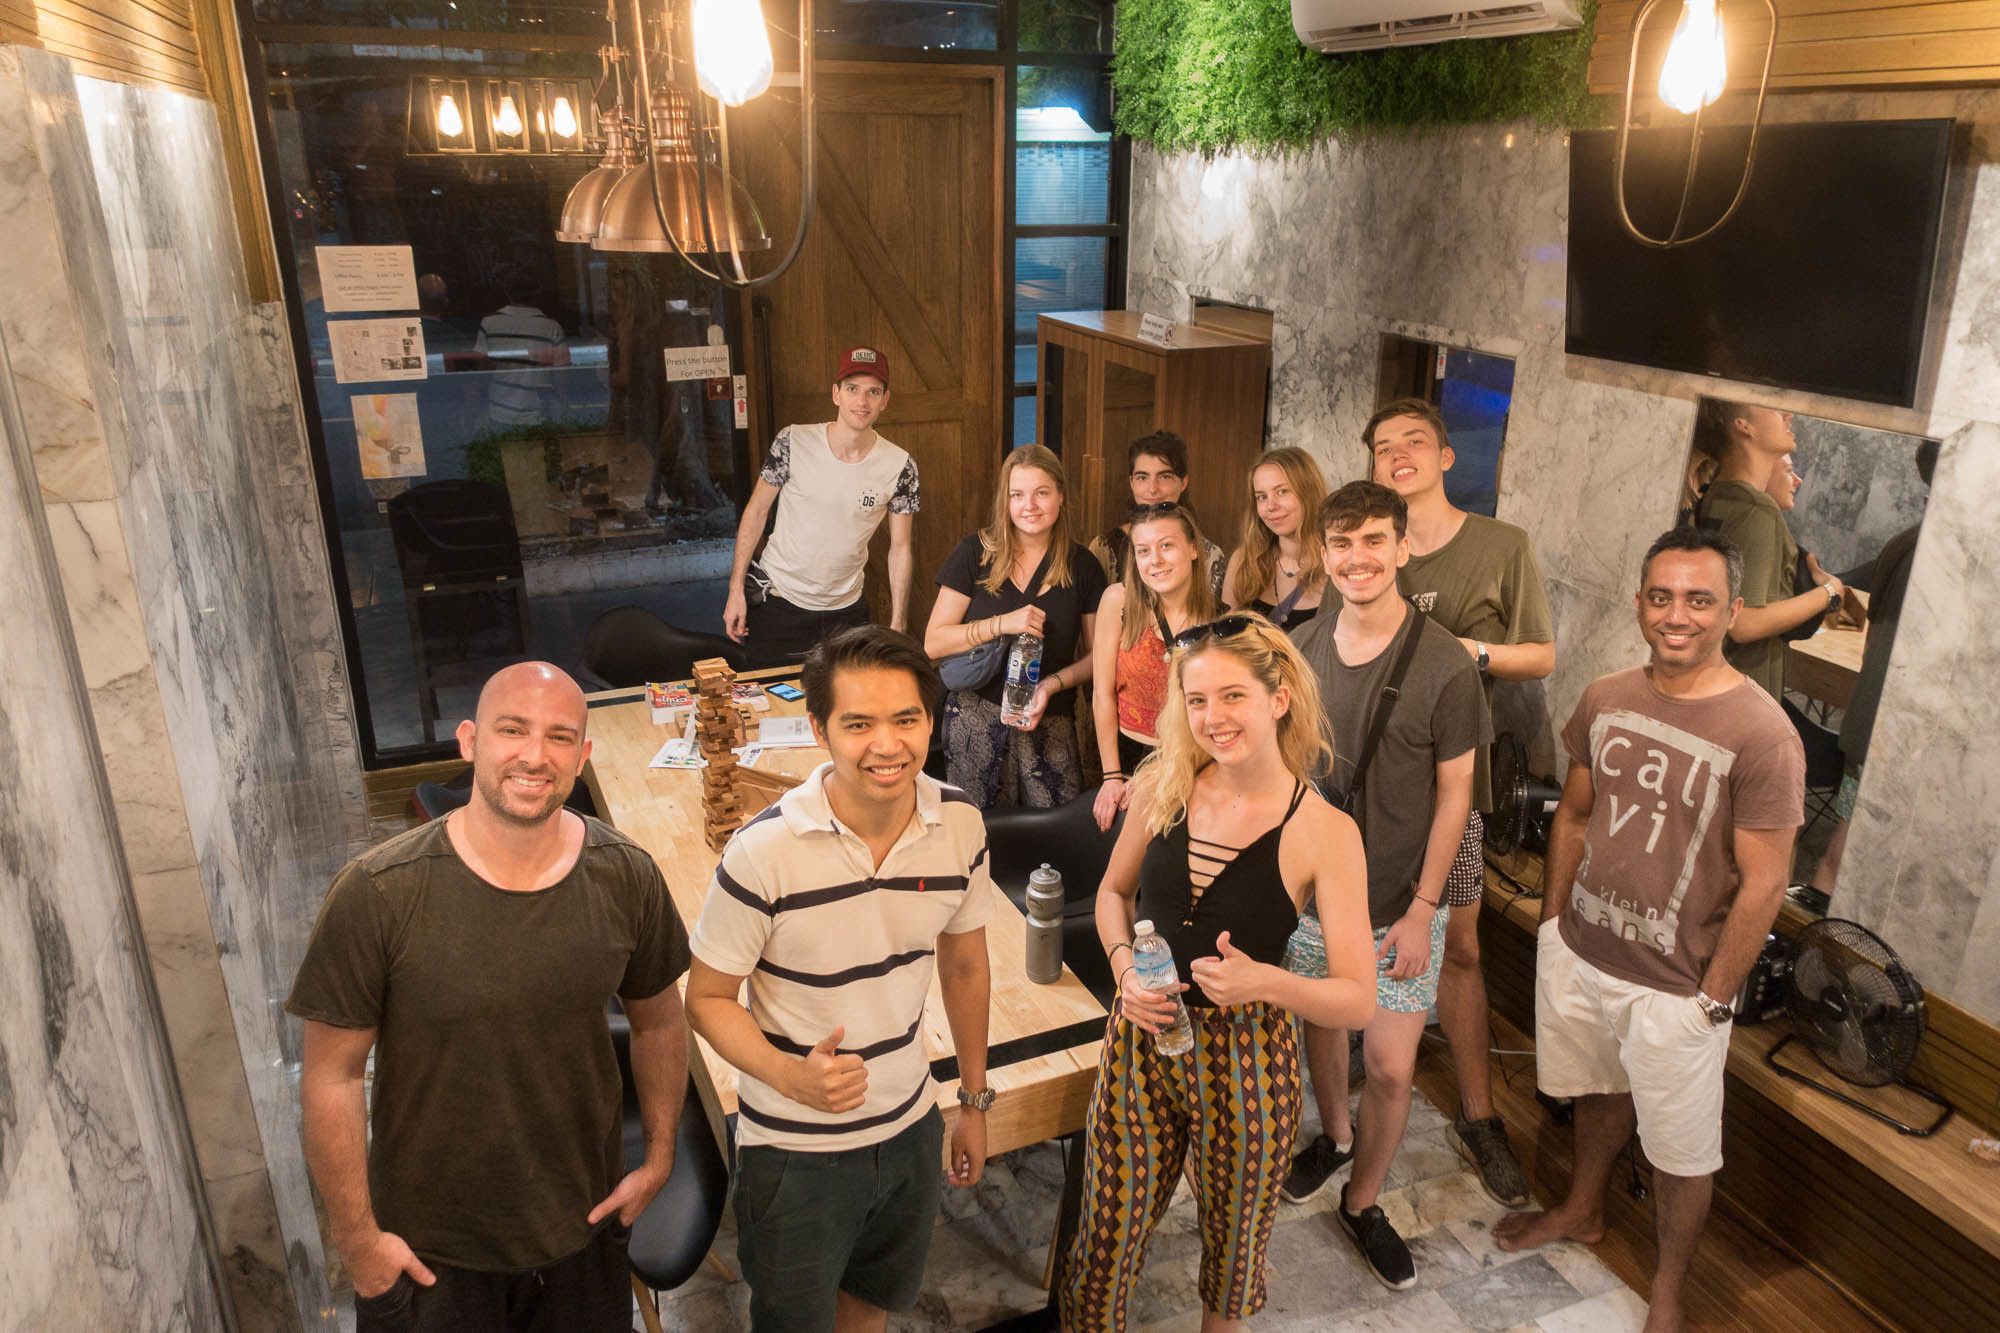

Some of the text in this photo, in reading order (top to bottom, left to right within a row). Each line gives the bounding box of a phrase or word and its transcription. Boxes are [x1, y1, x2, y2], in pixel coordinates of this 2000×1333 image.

[667, 358, 687, 366] Press
[702, 356, 727, 364] button
[694, 369, 716, 377] OPEN
[1576, 897, 1667, 955] eans
